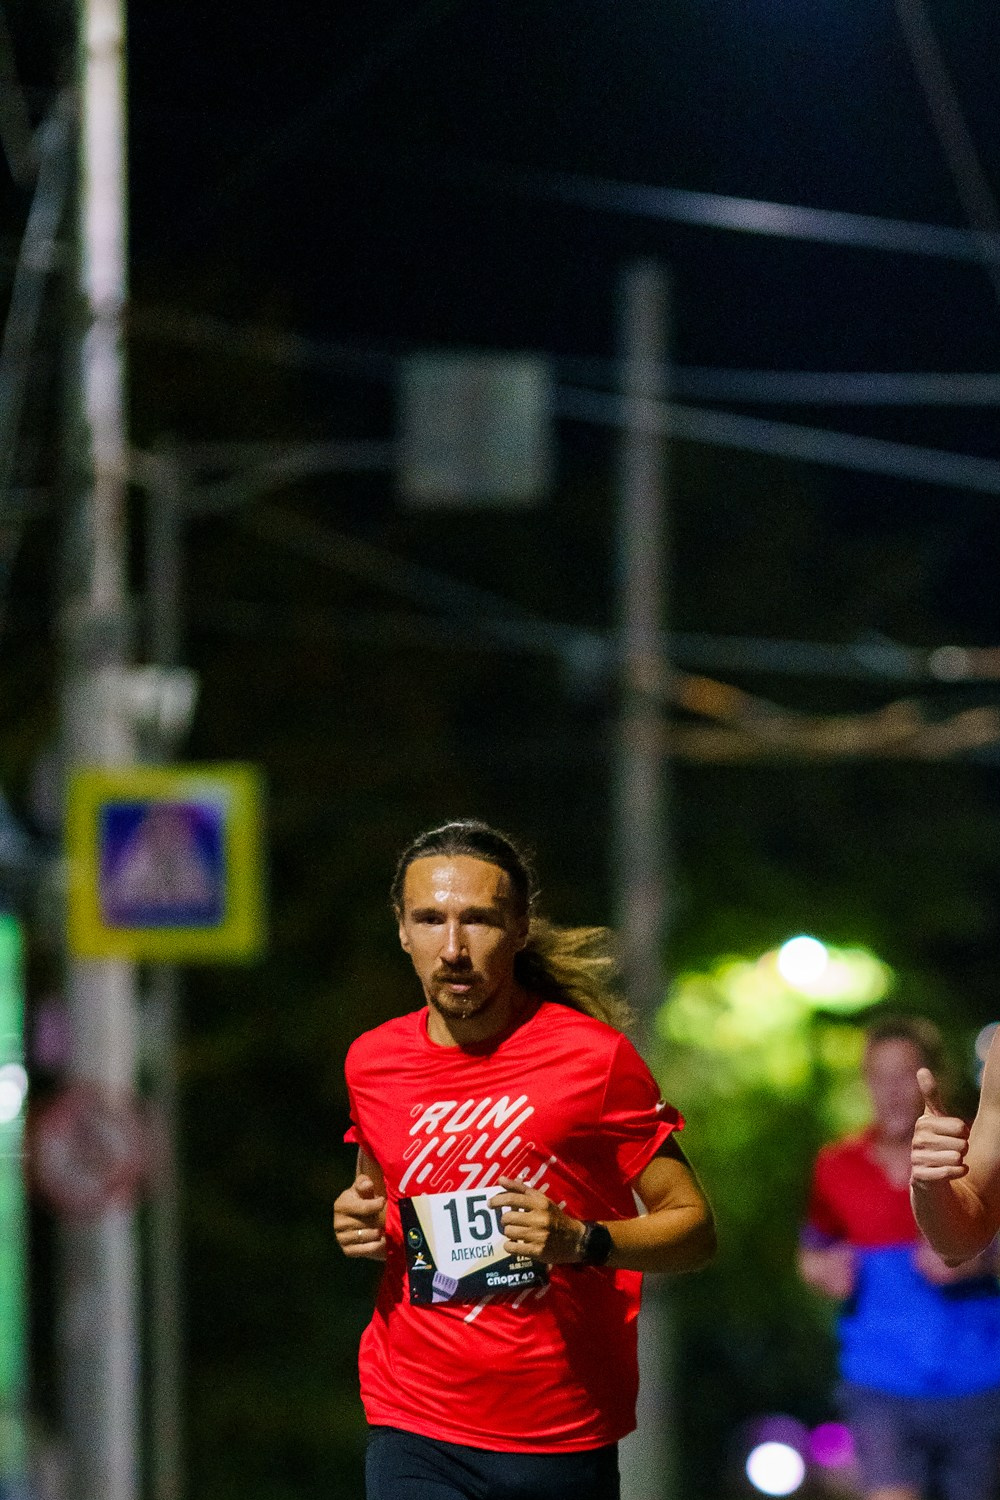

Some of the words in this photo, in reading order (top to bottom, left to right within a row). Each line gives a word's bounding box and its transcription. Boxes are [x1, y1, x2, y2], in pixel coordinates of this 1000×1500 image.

[409, 1095, 528, 1136] RUN
[451, 1243, 495, 1262] АЛЕКСЕЙ
[487, 1273, 520, 1286] СПОРТ
[521, 1271, 535, 1281] 40
